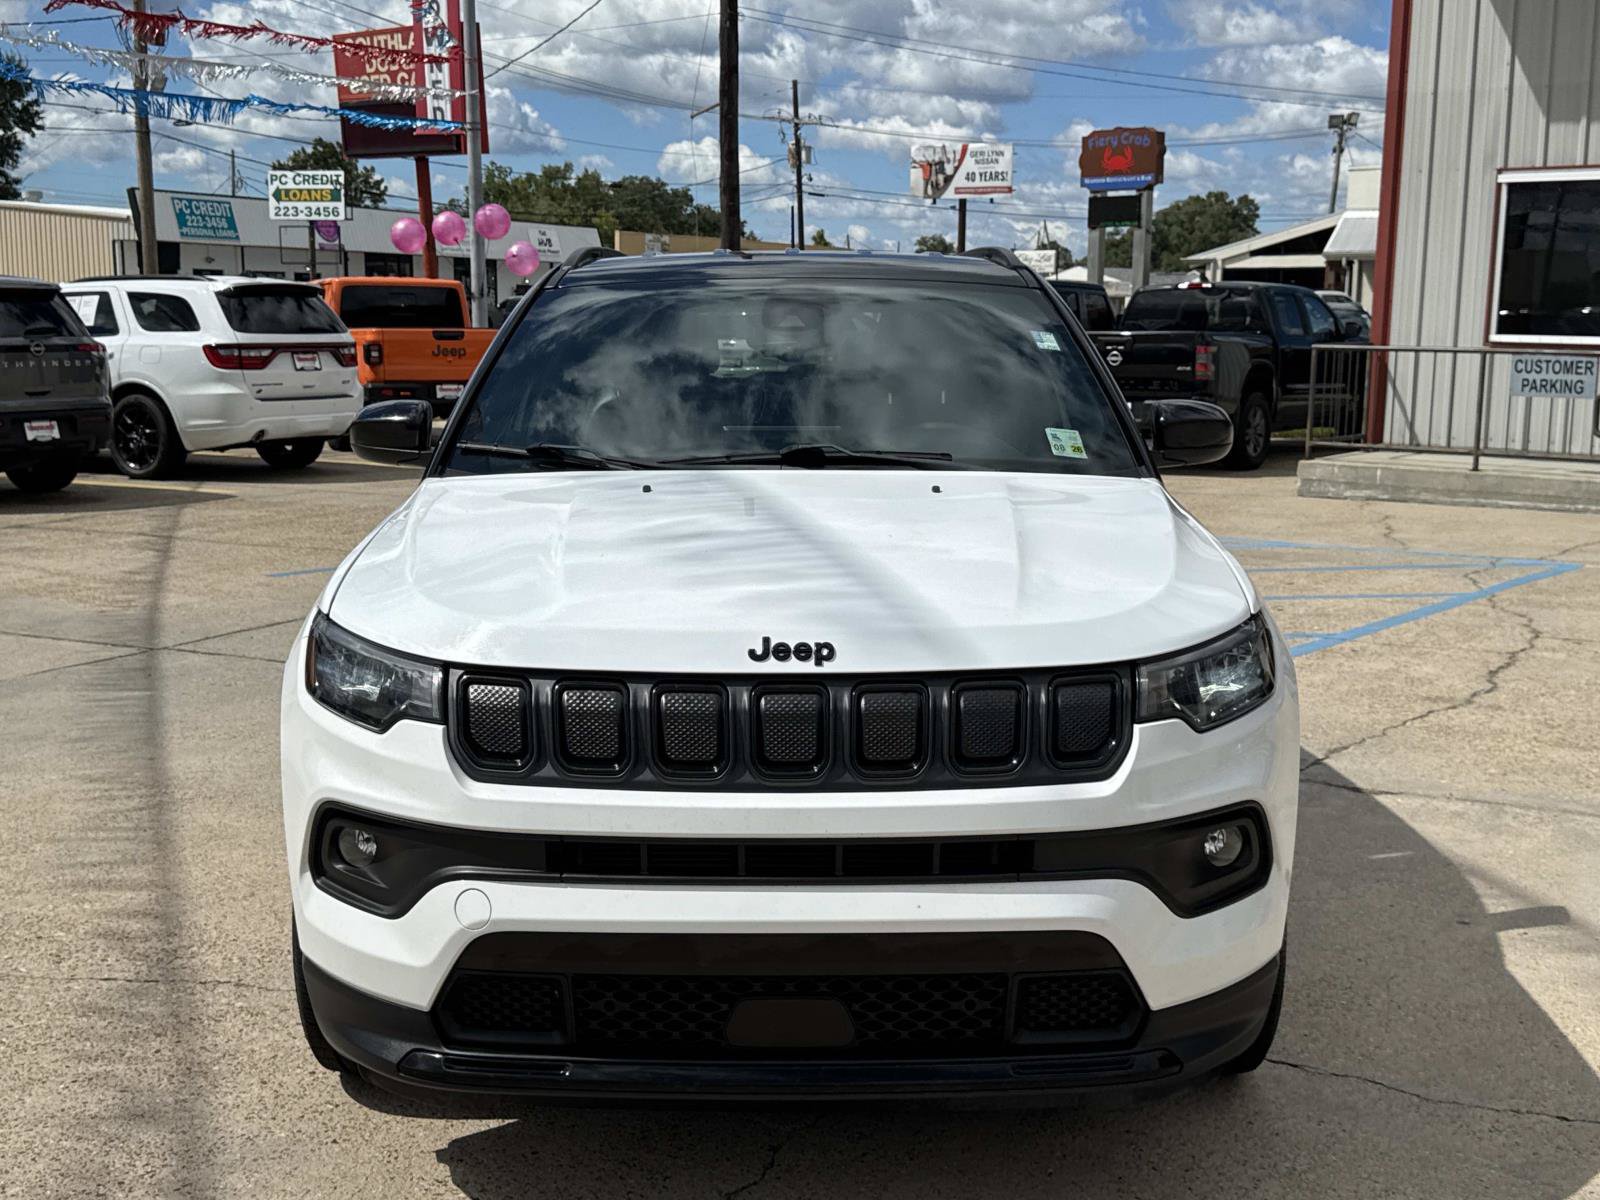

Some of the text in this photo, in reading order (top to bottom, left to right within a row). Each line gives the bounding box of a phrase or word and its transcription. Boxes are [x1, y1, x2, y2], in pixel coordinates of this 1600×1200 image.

[987, 150, 1005, 158] LYNN
[270, 173, 342, 186] PC CREDIT
[965, 170, 1009, 182] 40 YEARS!
[281, 189, 332, 201] LOANS
[173, 199, 231, 217] PC CREDIT
[274, 206, 340, 217] 223-3456
[432, 344, 466, 359] Jeep
[1514, 358, 1594, 376] CUSTOMER
[1521, 378, 1585, 395] PARKING
[747, 636, 837, 667] Jeep
